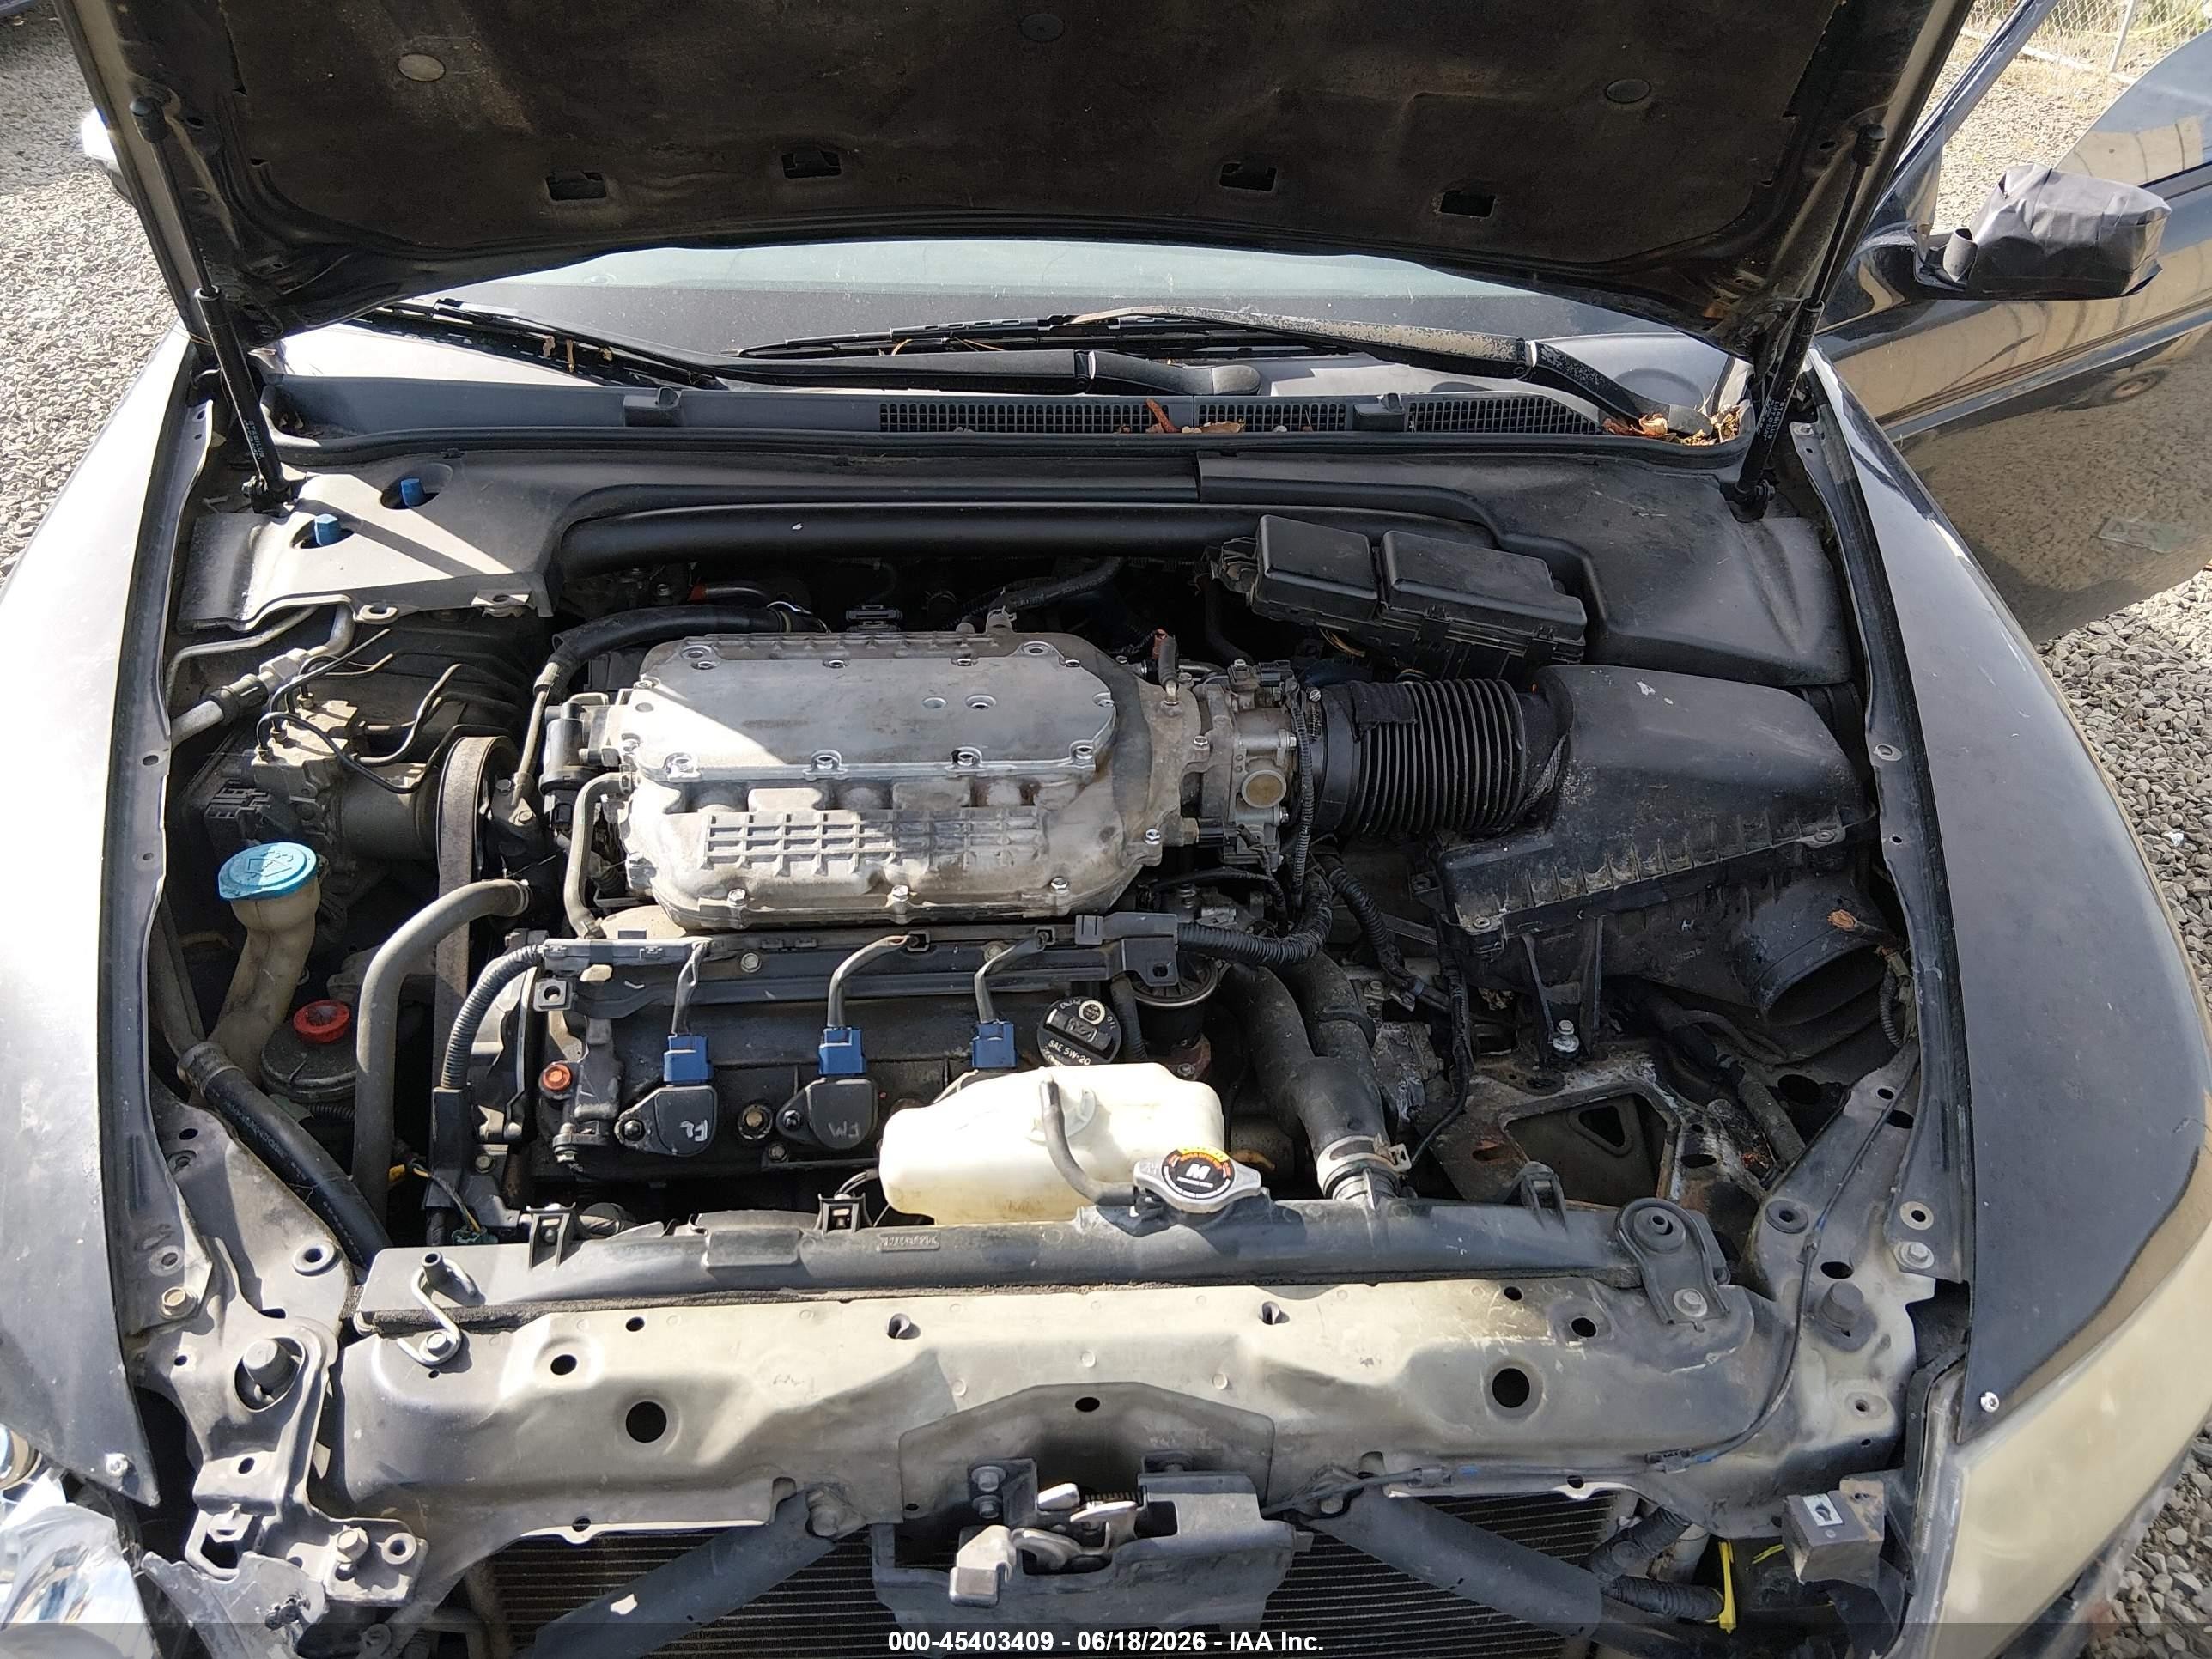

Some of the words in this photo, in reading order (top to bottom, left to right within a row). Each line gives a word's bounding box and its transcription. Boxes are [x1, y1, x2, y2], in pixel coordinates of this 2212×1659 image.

[1048, 1039, 1064, 1054] SAE
[1063, 1048, 1091, 1066] 5W-20
[1185, 1163, 1211, 1180] M
